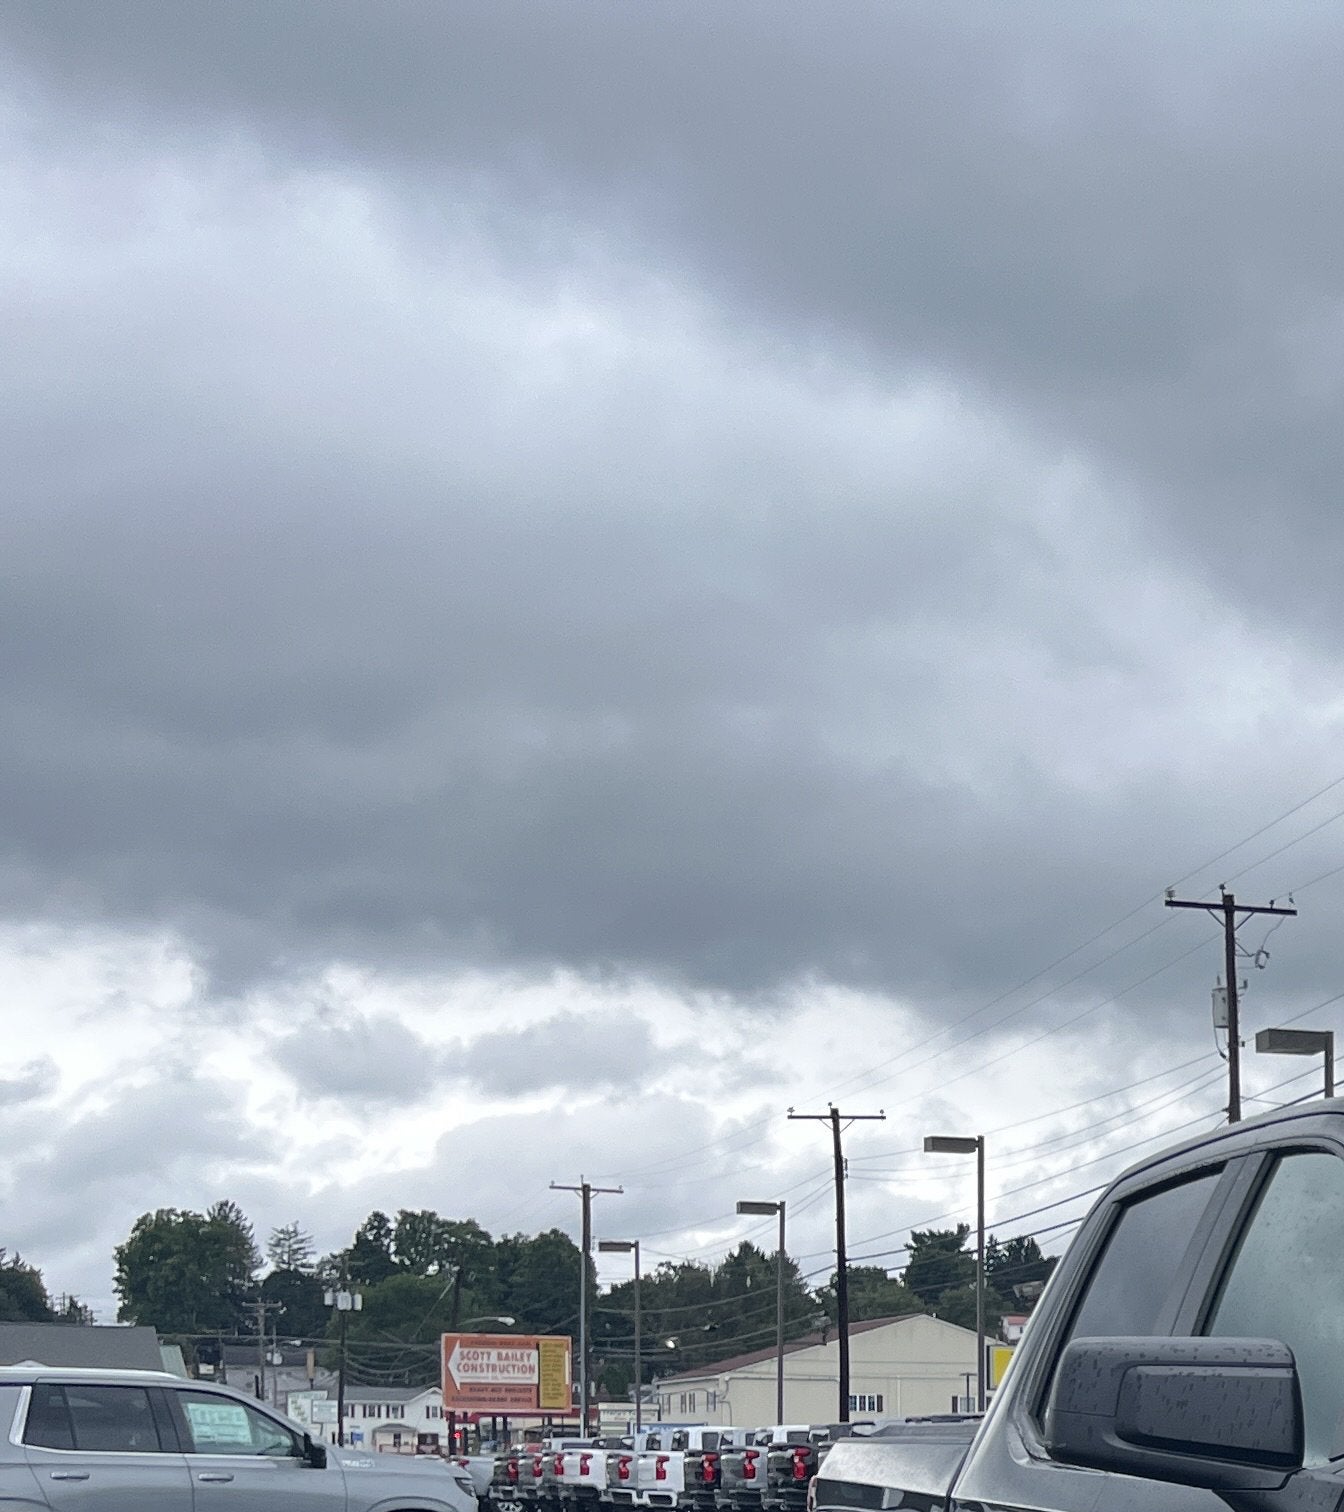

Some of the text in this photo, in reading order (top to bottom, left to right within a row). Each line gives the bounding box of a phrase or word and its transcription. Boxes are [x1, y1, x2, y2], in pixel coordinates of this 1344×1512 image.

[459, 1350, 532, 1362] SCOTT BAILEY
[456, 1363, 536, 1375] CONSTRUCTION
